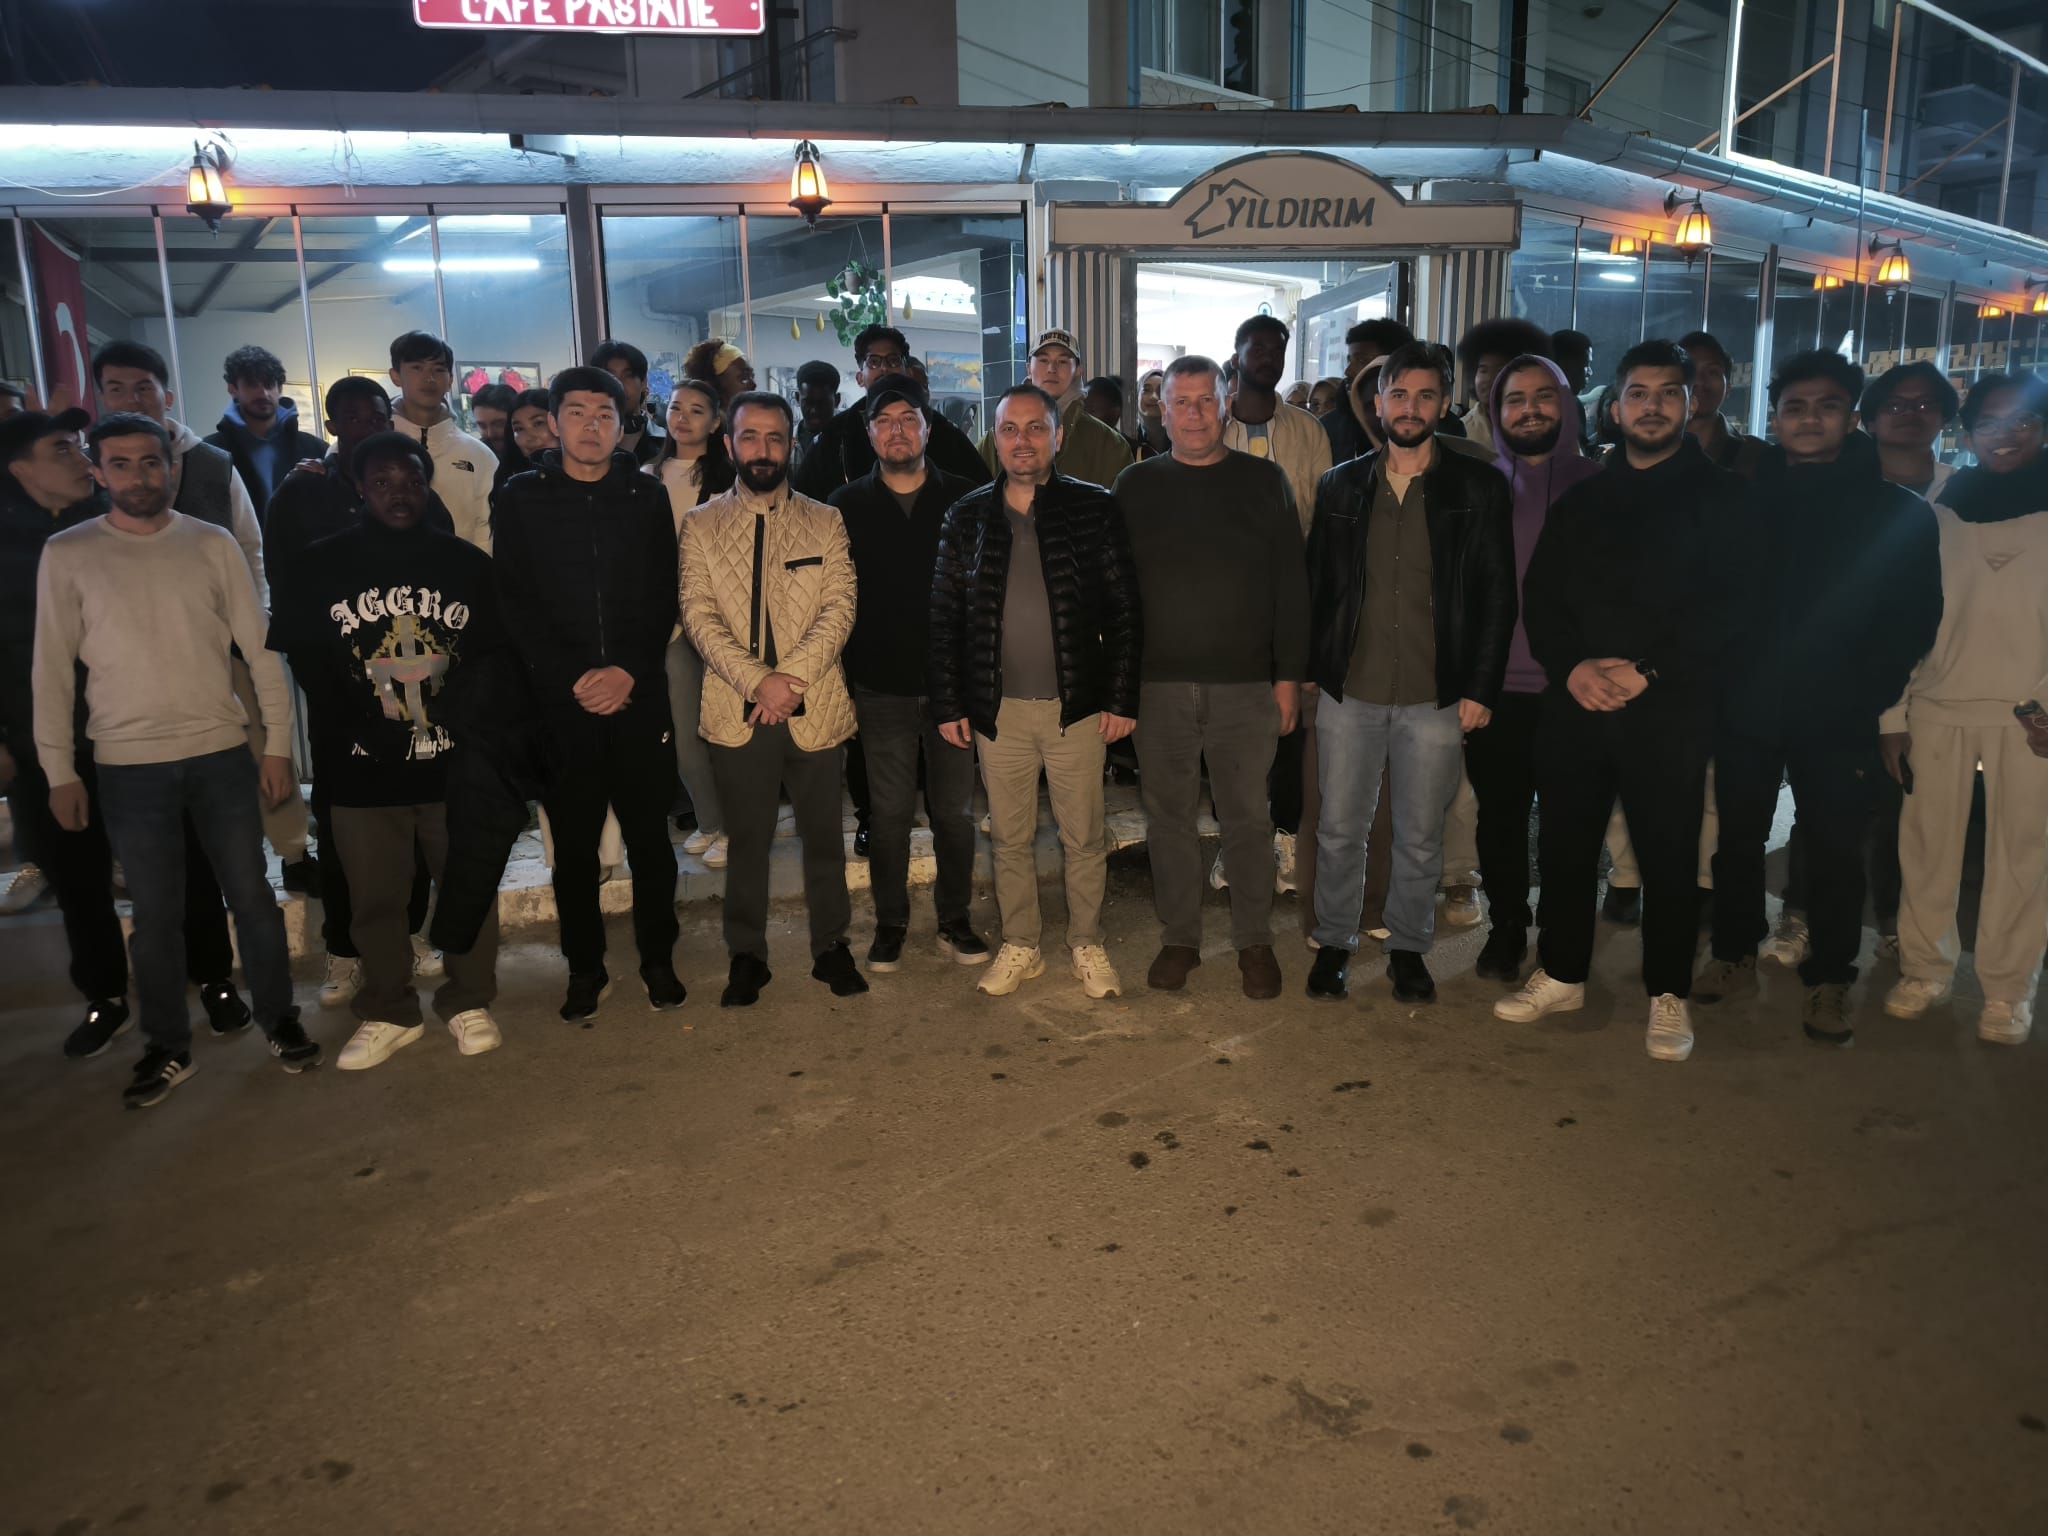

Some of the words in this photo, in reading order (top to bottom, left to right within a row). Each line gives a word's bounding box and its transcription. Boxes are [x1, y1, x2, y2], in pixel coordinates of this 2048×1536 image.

[462, 0, 555, 23] CAFE
[1226, 197, 1375, 228] YILDIRIM
[330, 585, 470, 637] AGGRO
